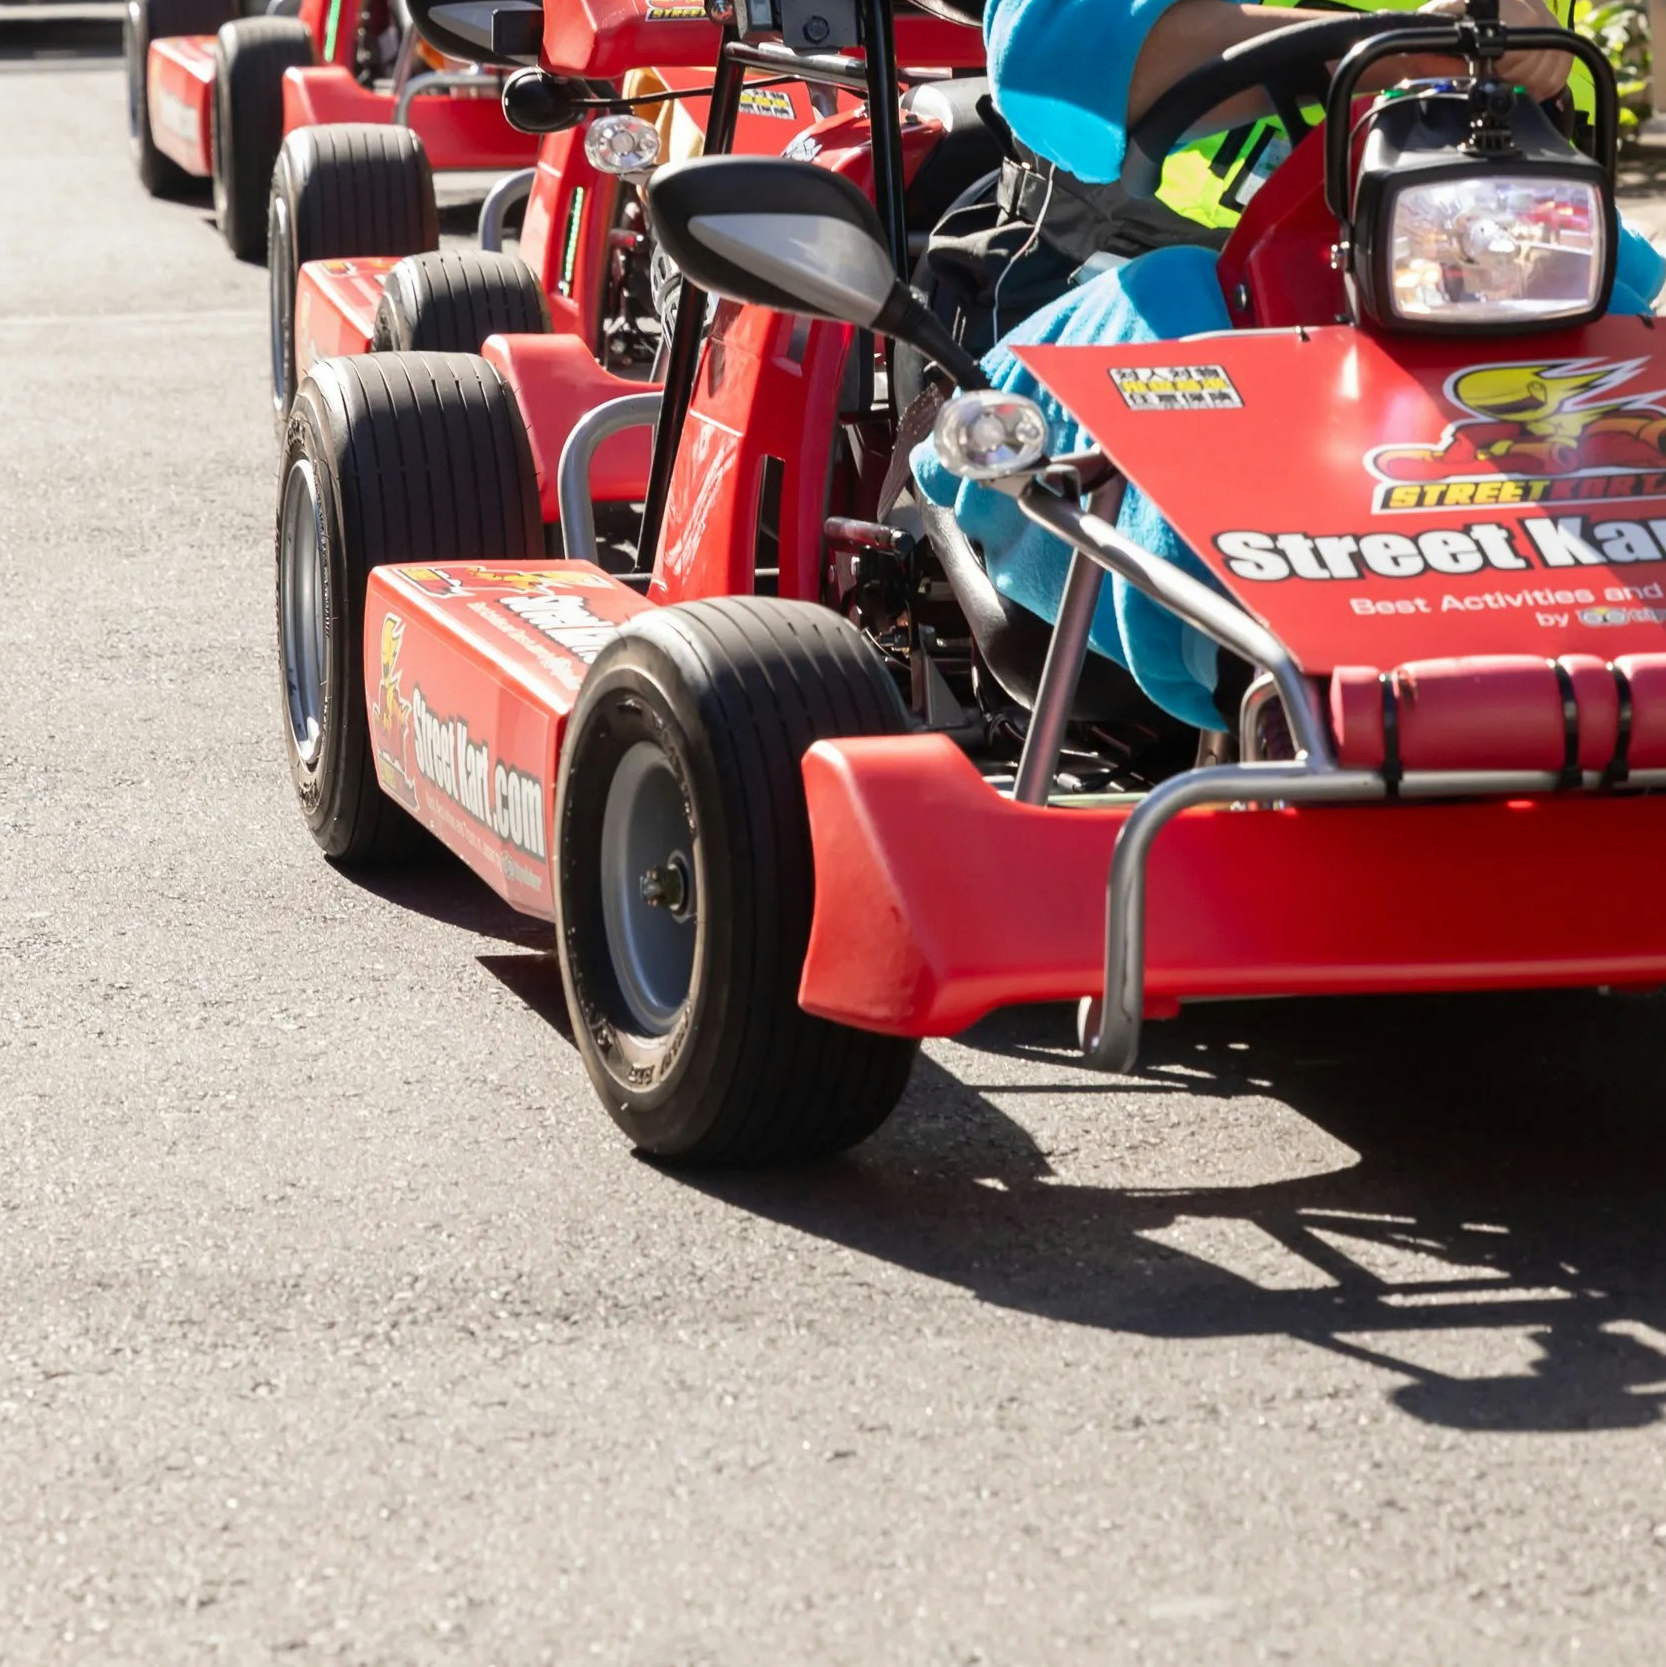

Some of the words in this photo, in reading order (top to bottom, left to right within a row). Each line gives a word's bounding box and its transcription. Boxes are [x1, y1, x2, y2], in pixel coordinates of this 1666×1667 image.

[1387, 479, 1550, 509] STREET
[1214, 521, 1530, 583] Street
[1349, 597, 1431, 616] Best
[1440, 587, 1595, 613] Activities
[1603, 581, 1664, 602] and
[1534, 611, 1570, 628] by
[412, 685, 460, 802] Street
[456, 718, 494, 829] Kart
